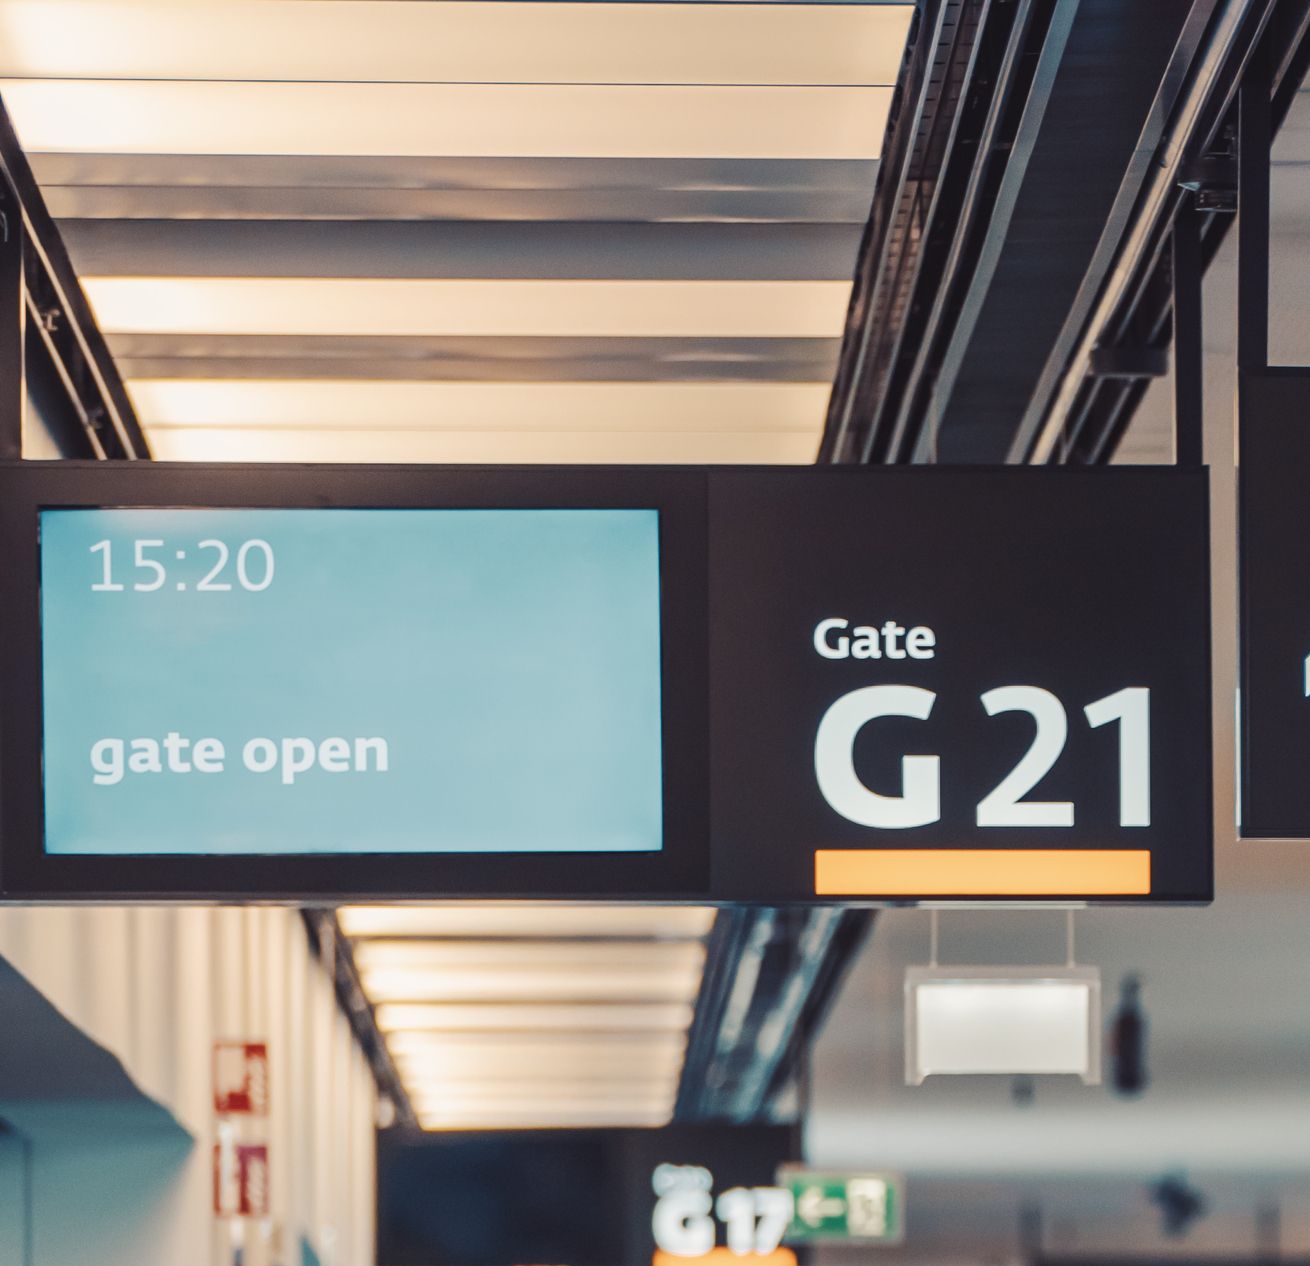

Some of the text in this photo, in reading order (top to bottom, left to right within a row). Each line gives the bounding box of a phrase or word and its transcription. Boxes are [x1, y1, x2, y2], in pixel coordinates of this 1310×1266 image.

[89, 538, 275, 592] 15:20
[813, 618, 936, 660] Gate
[90, 732, 389, 786] gate open
[814, 684, 1151, 829] G 21
[653, 1187, 794, 1256] G 17
